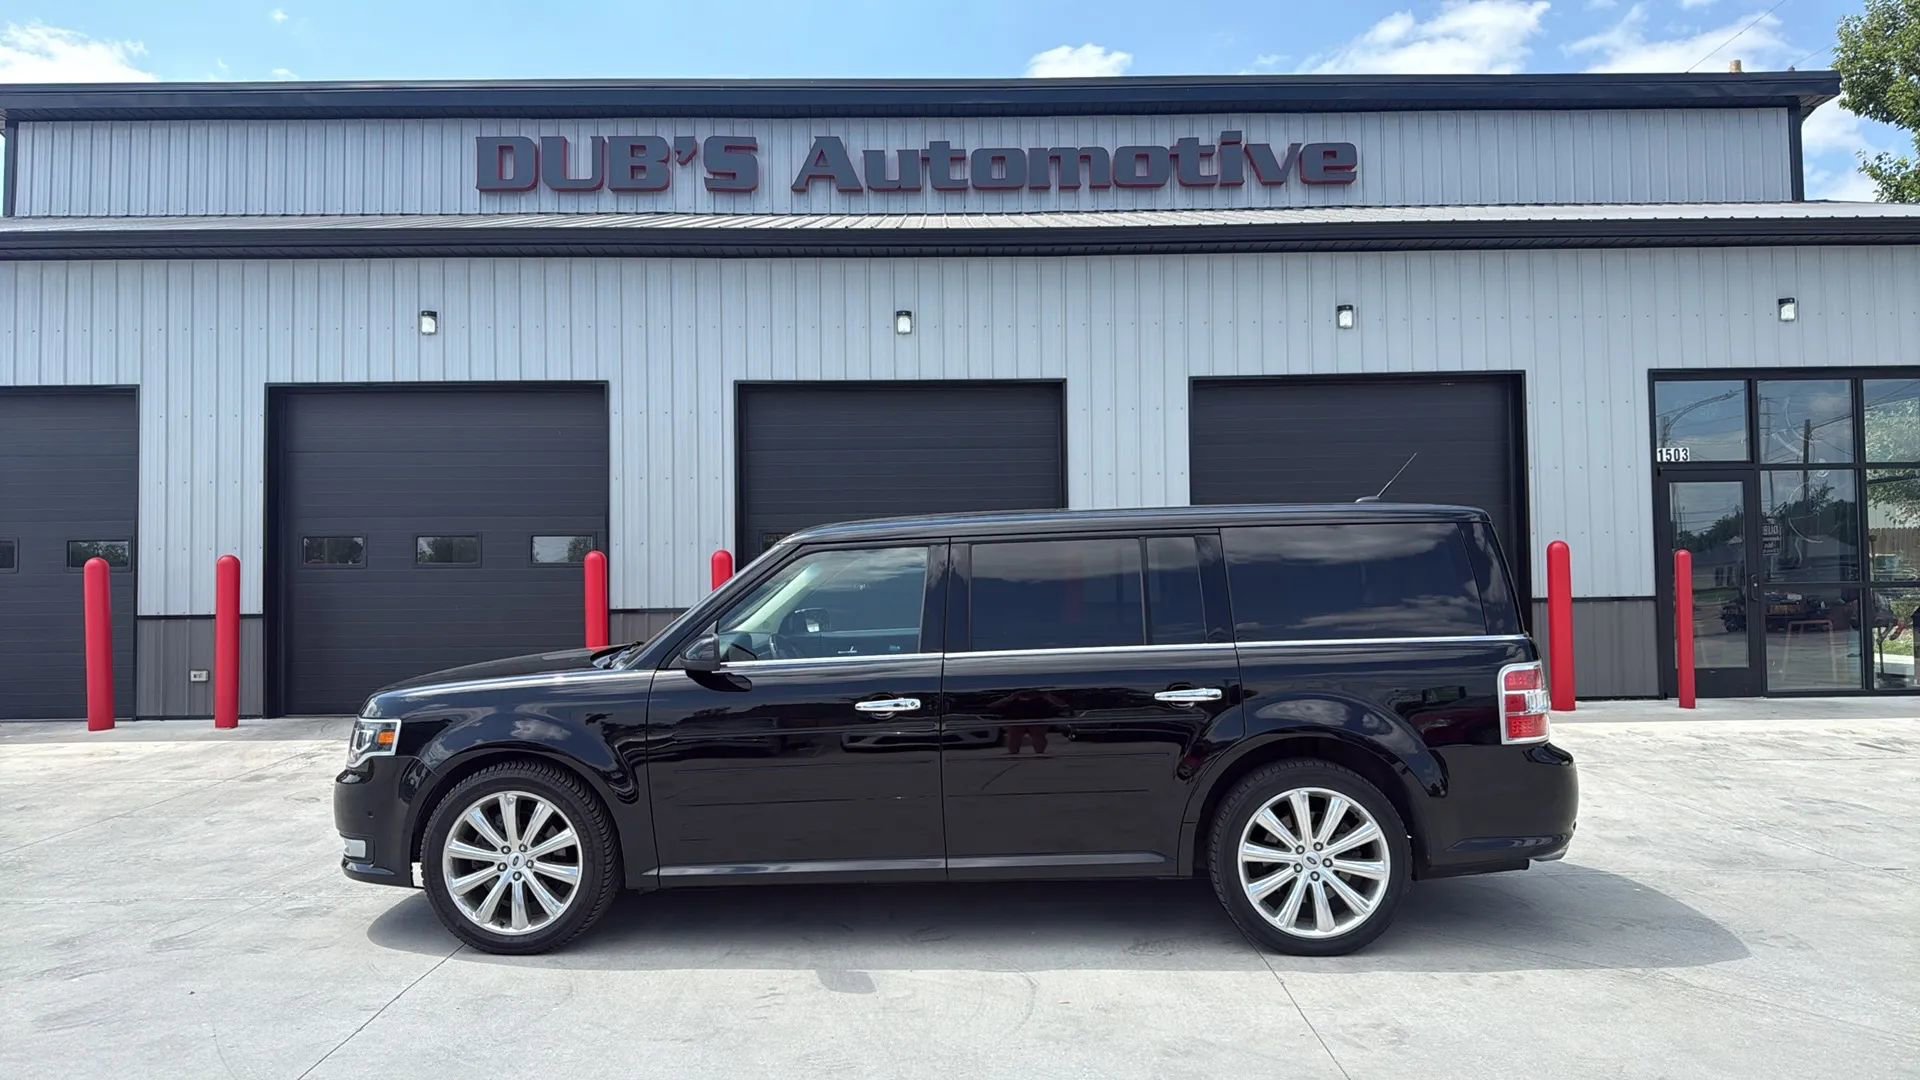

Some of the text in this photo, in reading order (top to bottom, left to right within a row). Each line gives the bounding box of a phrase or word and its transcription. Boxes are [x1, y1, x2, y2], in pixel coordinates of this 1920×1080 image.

[476, 130, 1357, 192] DUB'S Automotive
[1658, 448, 1689, 462] 1503
